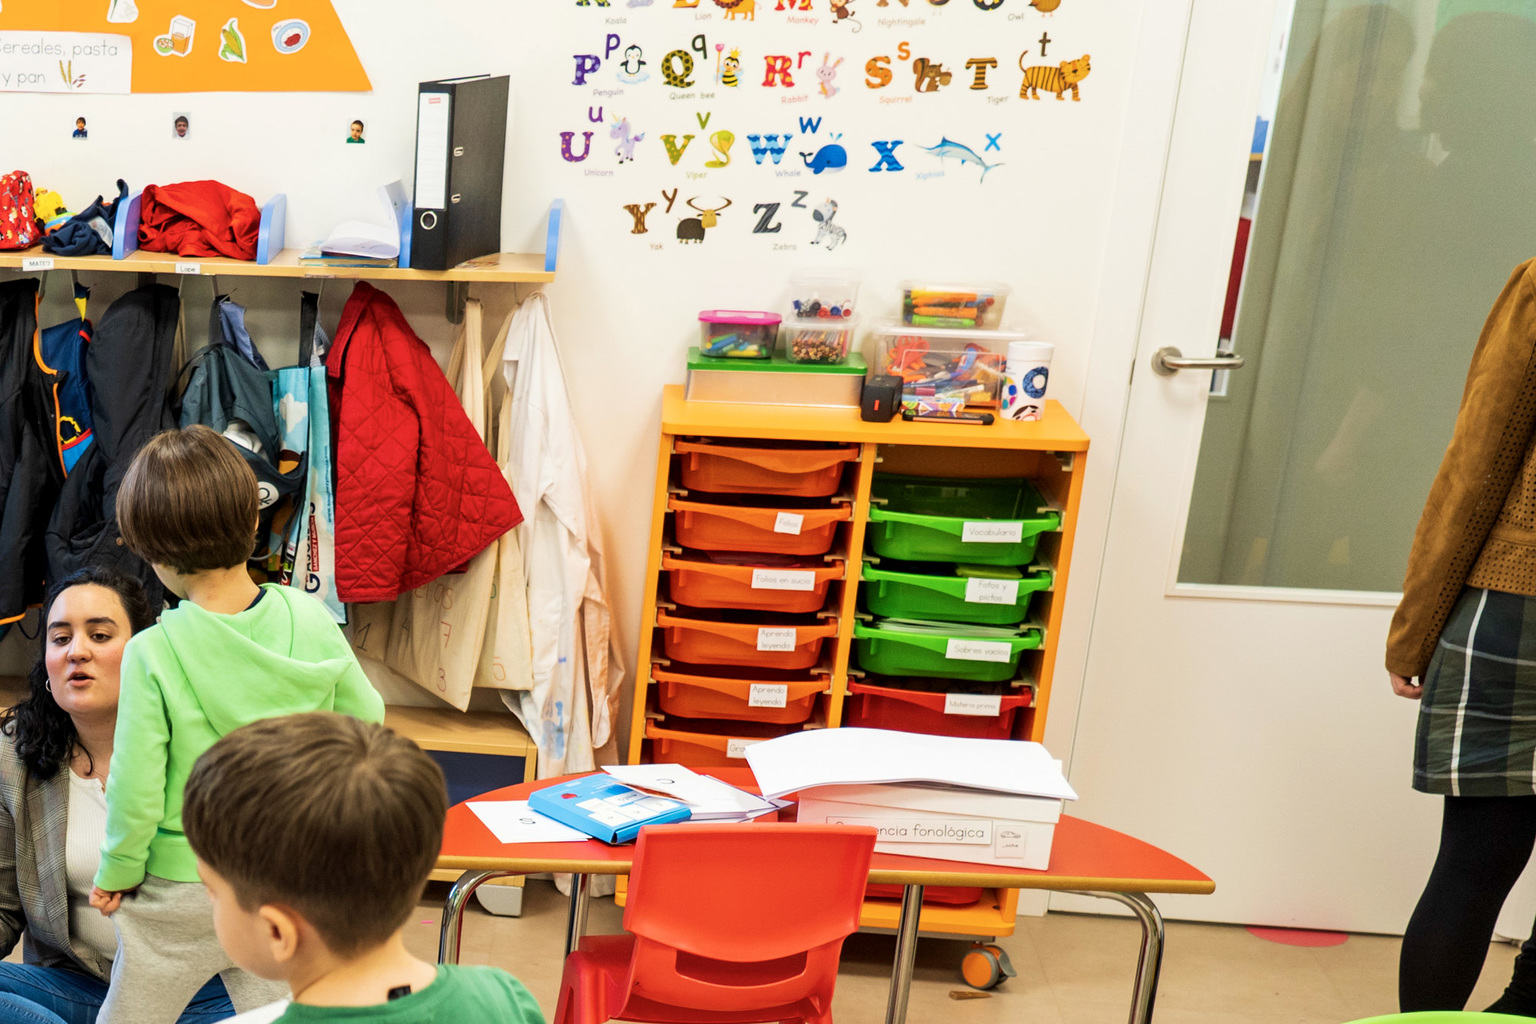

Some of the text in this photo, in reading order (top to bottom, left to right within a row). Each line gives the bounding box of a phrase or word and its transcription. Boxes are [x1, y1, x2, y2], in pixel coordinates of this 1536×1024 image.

[605, 15, 627, 25] Koala
[695, 11, 712, 21] Lion
[787, 15, 819, 26] Monkey
[878, 17, 926, 28] Nightingale
[72, 39, 118, 59] pasta
[797, 51, 812, 70] r
[572, 54, 602, 87] P
[661, 49, 696, 89] Q
[761, 55, 795, 89] R
[864, 53, 894, 90] S
[965, 57, 998, 90] T
[2, 72, 46, 87] y pan
[592, 87, 624, 98] Penguin
[781, 94, 808, 104] Rabbit
[986, 95, 1009, 106] Tiger
[559, 131, 594, 163] U
[660, 134, 695, 166] V
[746, 132, 794, 165] W
[868, 140, 904, 173] X
[583, 168, 614, 178] Unicorn
[686, 170, 708, 181] Viper
[775, 169, 801, 178] Whale
[623, 202, 657, 235] Y
[752, 203, 782, 235] Z
[649, 242, 664, 251] Yak
[772, 242, 797, 251] Zebra
[969, 528, 1016, 536] Vocabulario
[913, 823, 984, 841] fonológica
